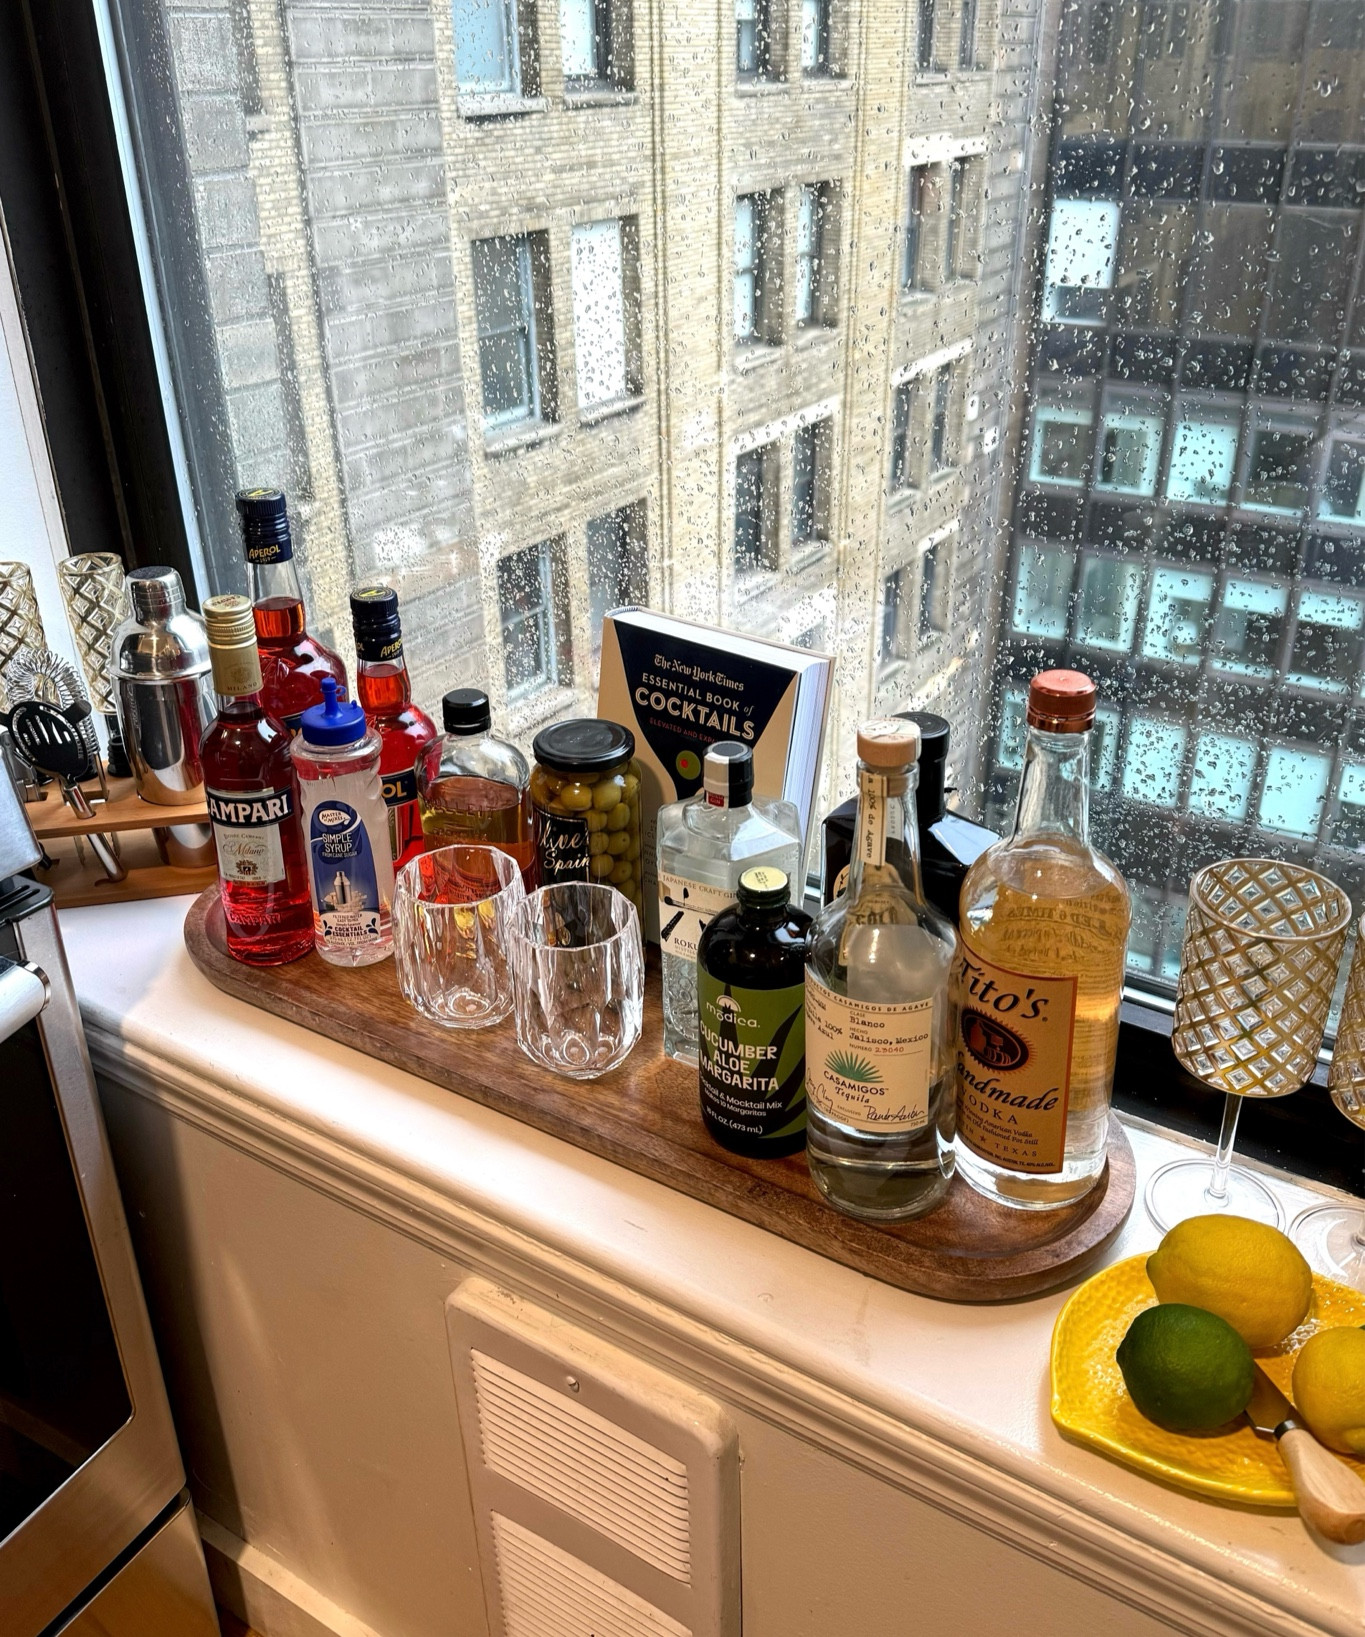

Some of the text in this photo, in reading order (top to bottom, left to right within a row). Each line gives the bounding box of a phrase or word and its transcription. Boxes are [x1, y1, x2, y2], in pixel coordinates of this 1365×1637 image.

[249, 544, 281, 559] APEROL
[654, 654, 744, 691] The New York Times
[227, 682, 258, 691] MILANO
[642, 672, 755, 717] ESSENTIAL BOOK of
[635, 687, 756, 740] COCKTAILS
[650, 717, 682, 735] ELEVATED
[683, 729, 698, 739] AND
[206, 795, 289, 823] AMPARI
[322, 832, 353, 844] SIMPLE
[324, 843, 353, 853] SYRUP
[544, 849, 590, 876] Spain
[663, 875, 697, 890] JAPANESE
[698, 884, 721, 896] CRAFT
[333, 929, 368, 937] ESSENTIALS
[834, 995, 882, 1012] CASAMIGOS
[902, 1001, 929, 1012] AGAVE
[849, 1016, 885, 1029] Blanco
[700, 1020, 778, 1060] CUCUMBER
[849, 1032, 929, 1047] Jalisco, Mexico
[700, 1049, 780, 1091] MARGARITA
[713, 1049, 751, 1075] ALOE
[823, 1070, 886, 1097] CASAMIGOS
[719, 1093, 726, 1101] &
[726, 1095, 765, 1110] Mocktail
[766, 1101, 783, 1109] Mix
[835, 1086, 870, 1104] Tequila
[727, 1104, 768, 1117] Margaritas
[729, 1119, 746, 1132] (473
[982, 1124, 1011, 1141] Fashioned
[1012, 1133, 1023, 1143] Pot
[984, 1119, 1012, 1135] American
[1013, 1129, 1033, 1137] Vodka
[994, 1142, 1037, 1157] TEXAS
